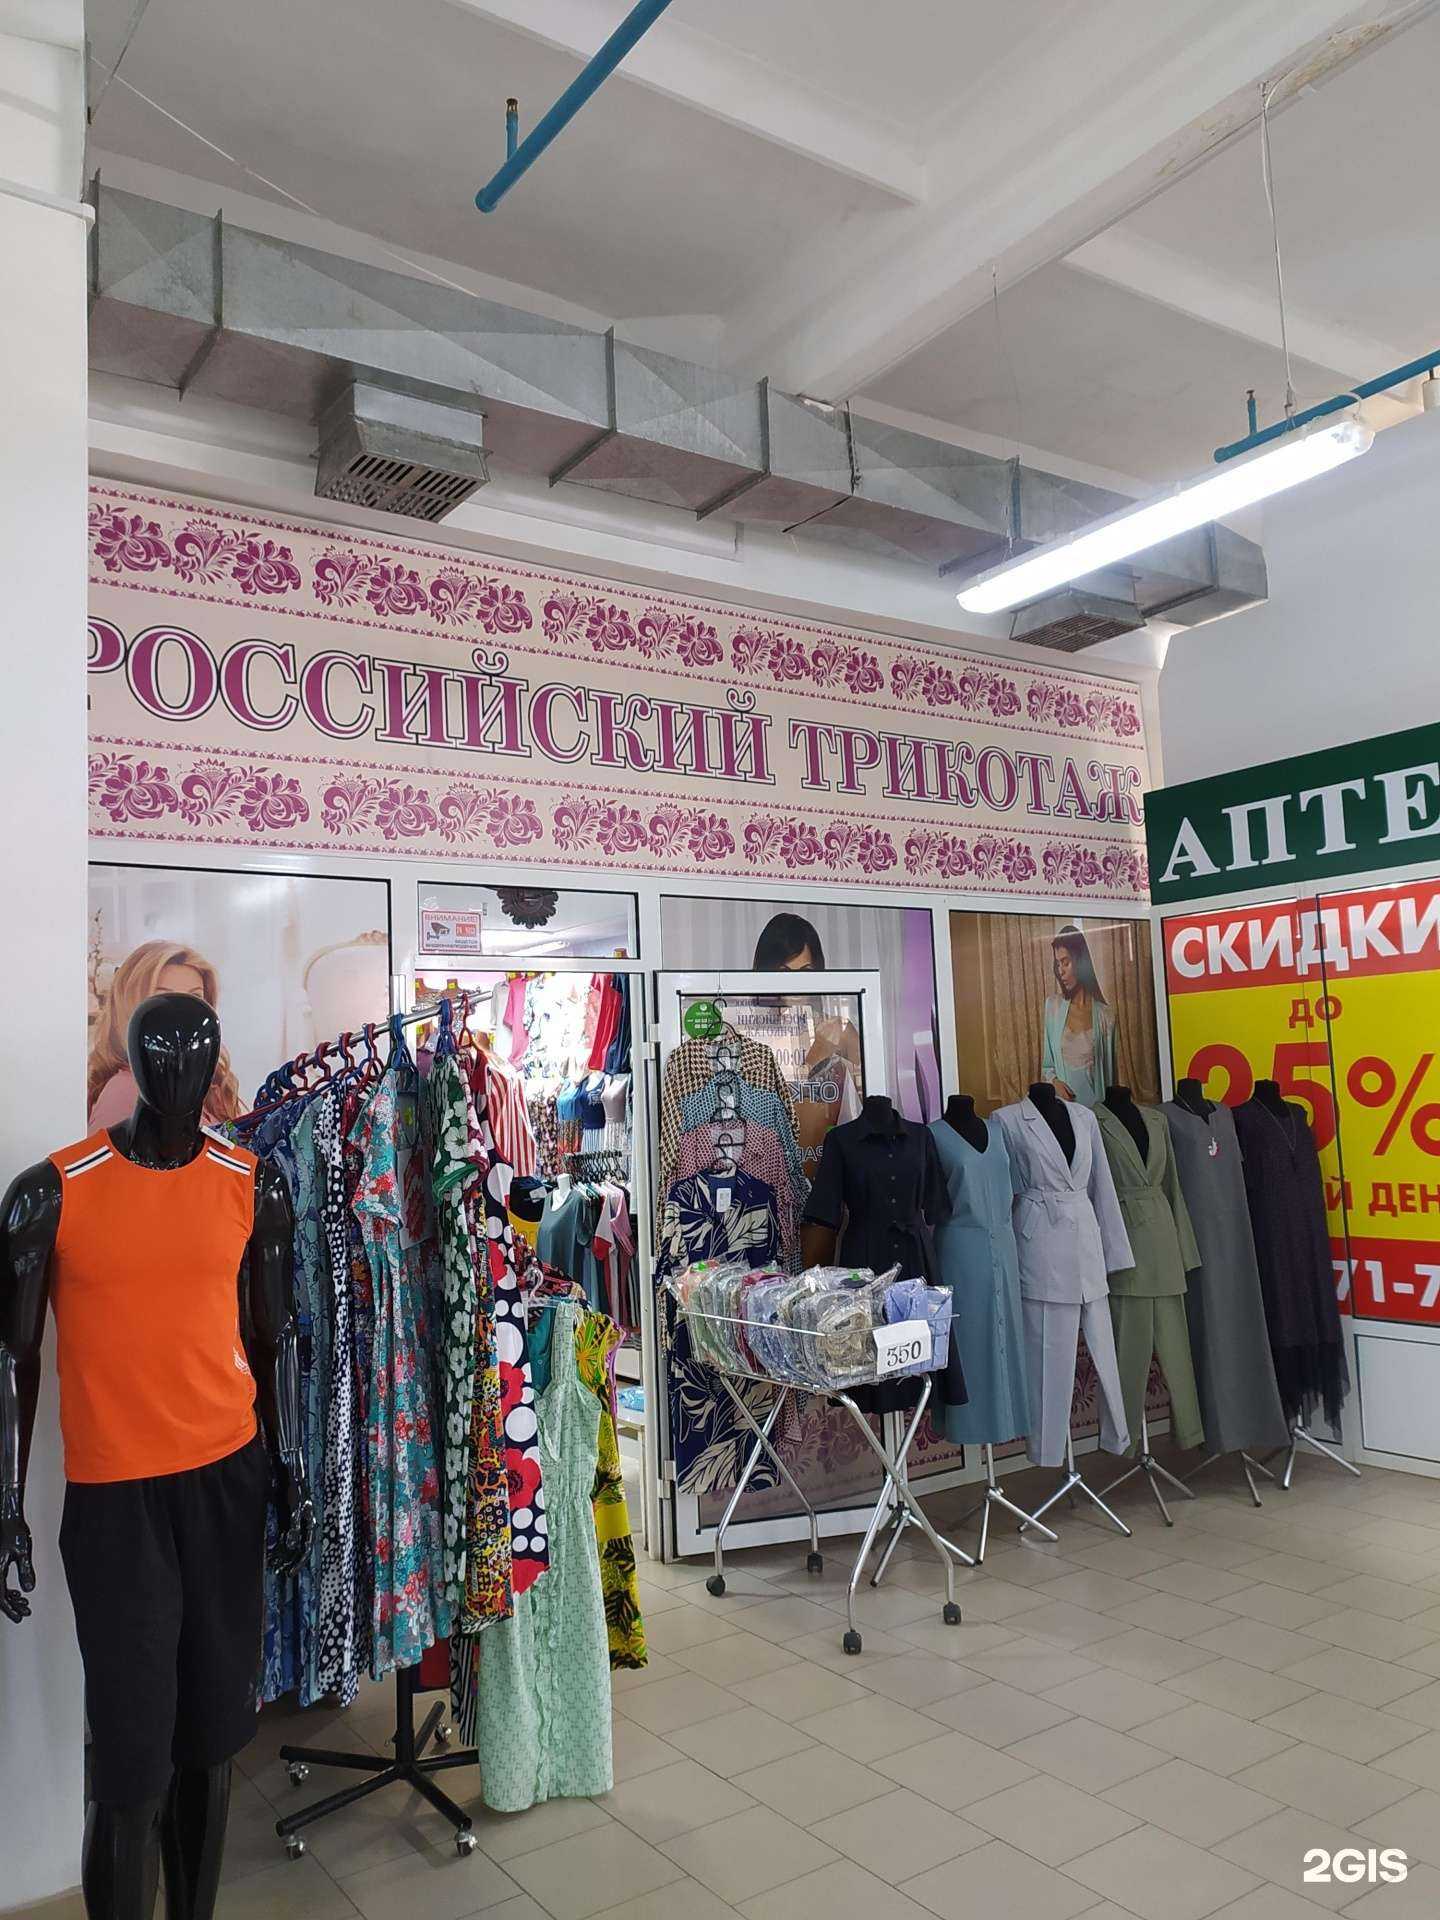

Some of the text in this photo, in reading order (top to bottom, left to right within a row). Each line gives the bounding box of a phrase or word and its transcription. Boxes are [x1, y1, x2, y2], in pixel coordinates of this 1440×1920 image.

[789, 718, 1144, 827] ТРИКОТАЖ
[1158, 762, 1440, 883] АПТЕ
[1171, 894, 1440, 978] СКИДКИ
[887, 1341, 922, 1367] 550
